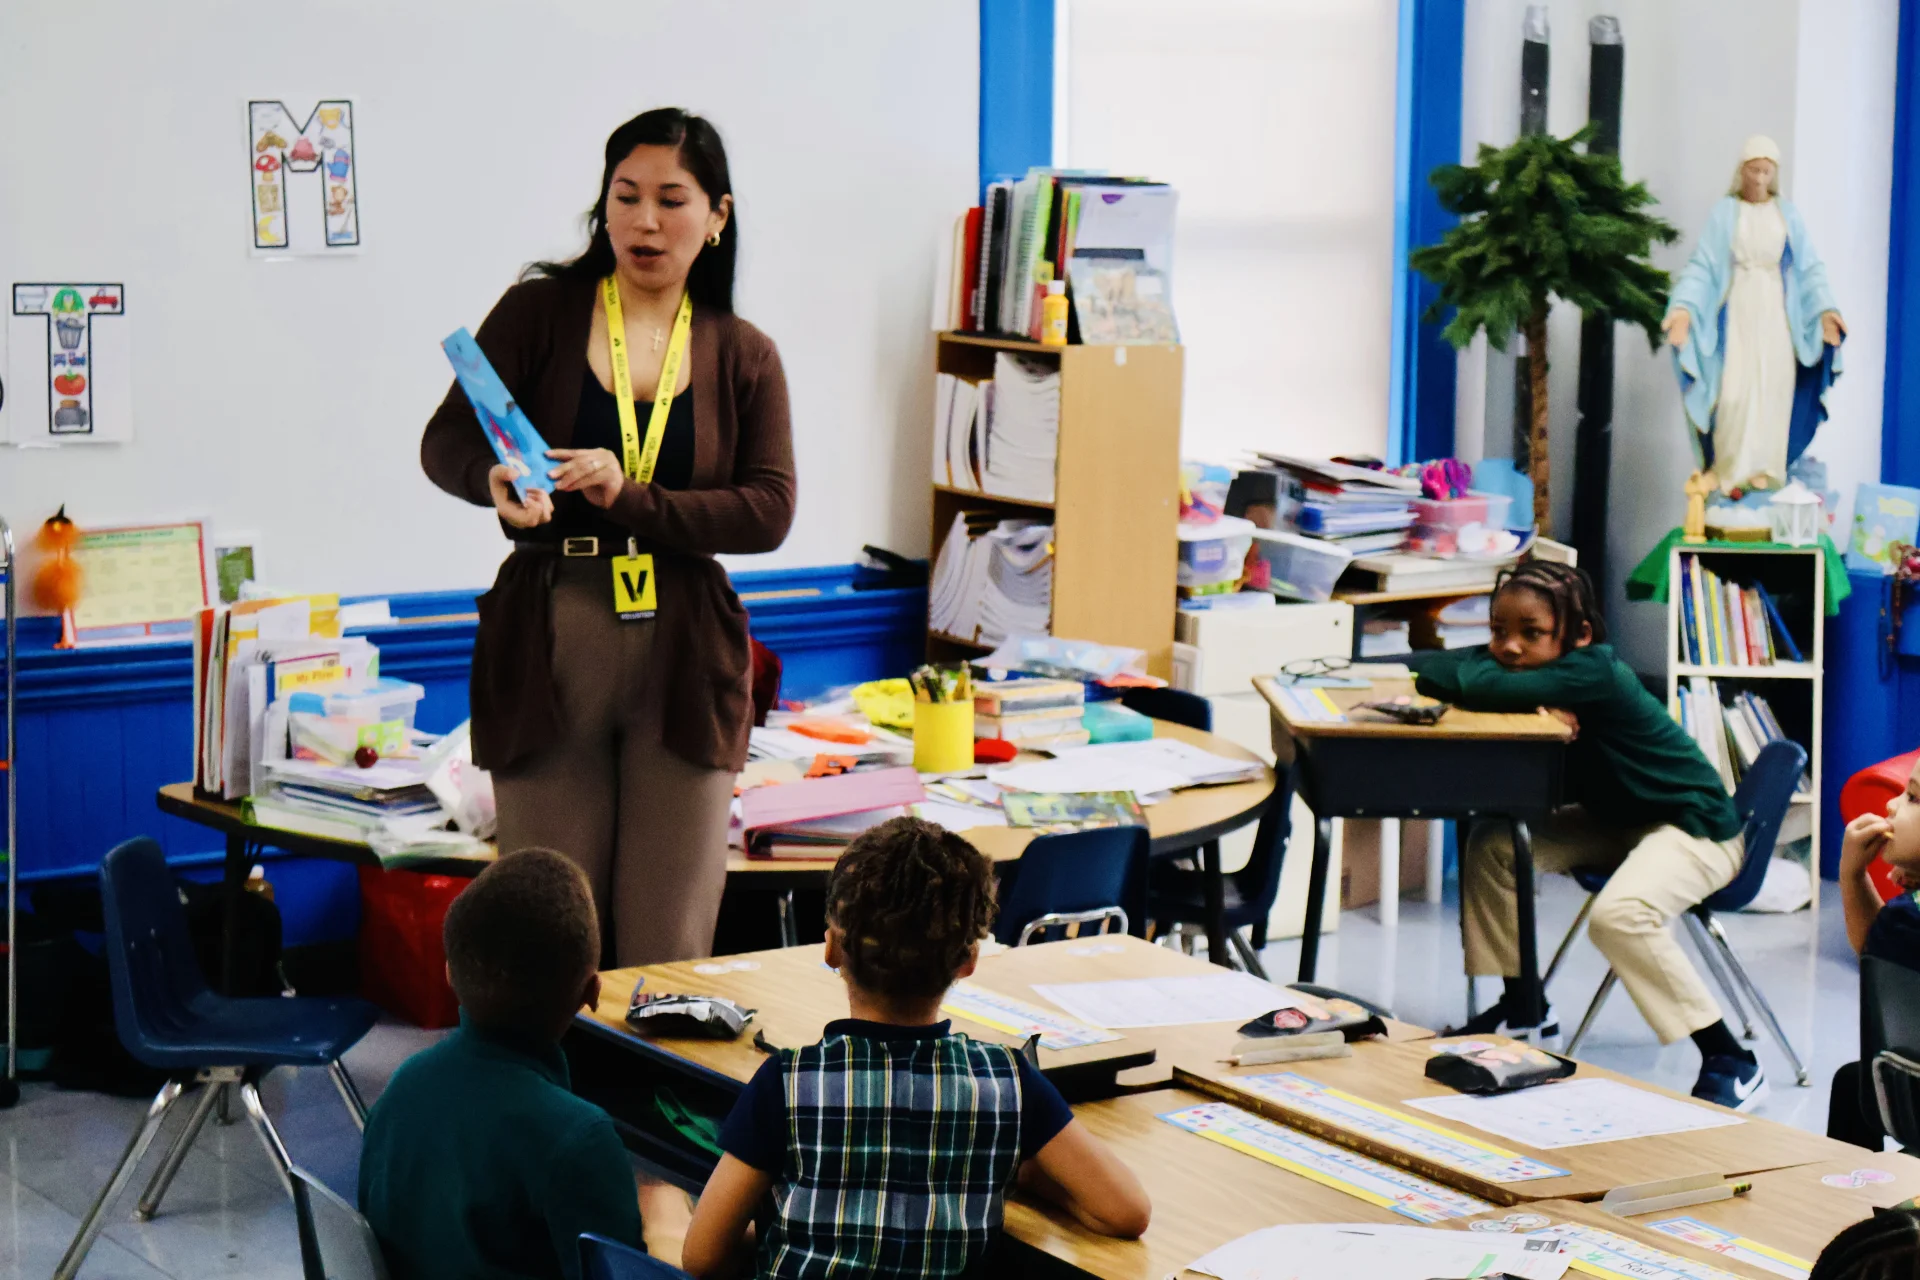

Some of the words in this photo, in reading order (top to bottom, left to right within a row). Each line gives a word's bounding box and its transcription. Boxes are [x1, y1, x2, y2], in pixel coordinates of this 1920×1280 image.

[249, 100, 359, 248] M
[13, 283, 124, 434] T
[620, 569, 648, 603] V
